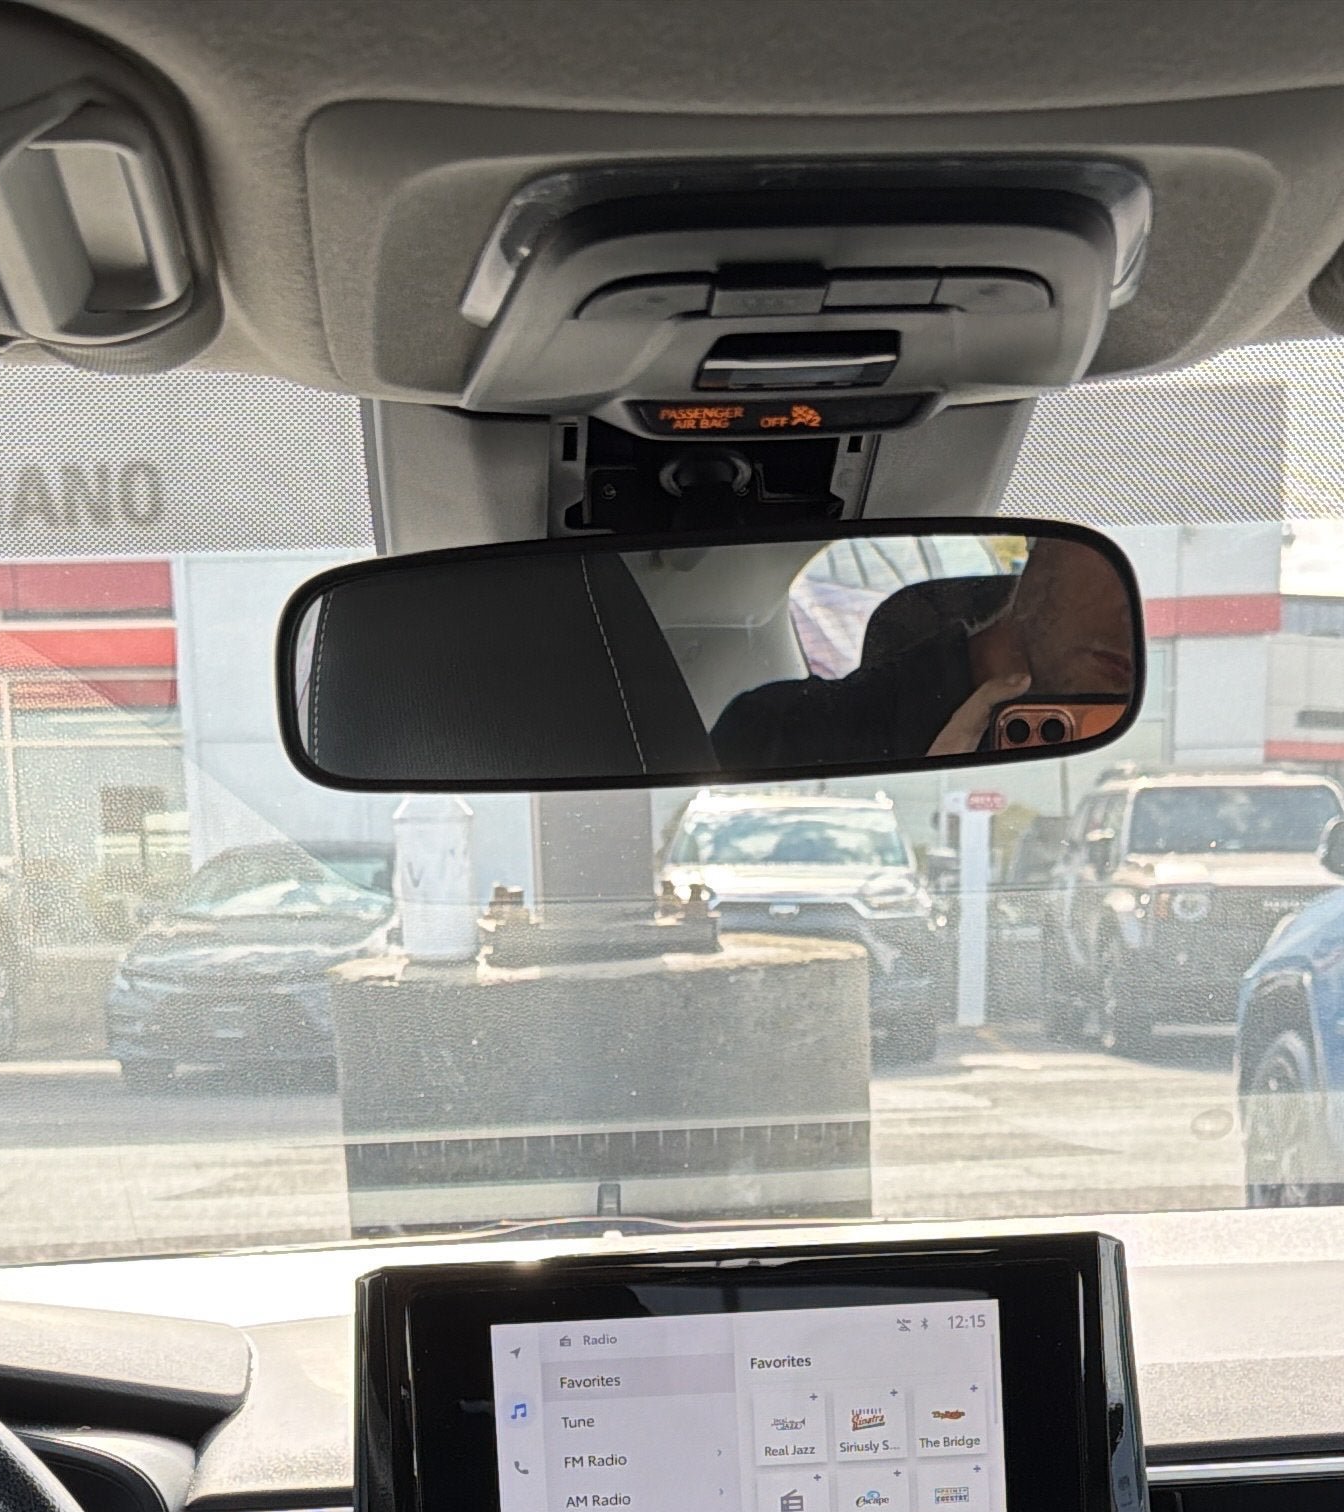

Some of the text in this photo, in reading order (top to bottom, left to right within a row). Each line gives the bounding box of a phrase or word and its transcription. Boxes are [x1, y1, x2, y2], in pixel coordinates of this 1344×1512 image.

[659, 407, 745, 420] PASSENGER
[672, 419, 731, 429] AIR BAG
[760, 416, 790, 428] OFF
[948, 1314, 986, 1329] 12:15
[582, 1333, 617, 1346] Radio
[750, 1355, 812, 1369] Favorites
[560, 1374, 621, 1389] Favorites
[561, 1416, 595, 1429] Tune
[839, 1440, 880, 1454] Siriusly
[919, 1436, 981, 1449] The Bridge
[764, 1444, 816, 1457] Real Jazz
[564, 1453, 627, 1469] FM Radio
[566, 1493, 631, 1508] AM Radio
